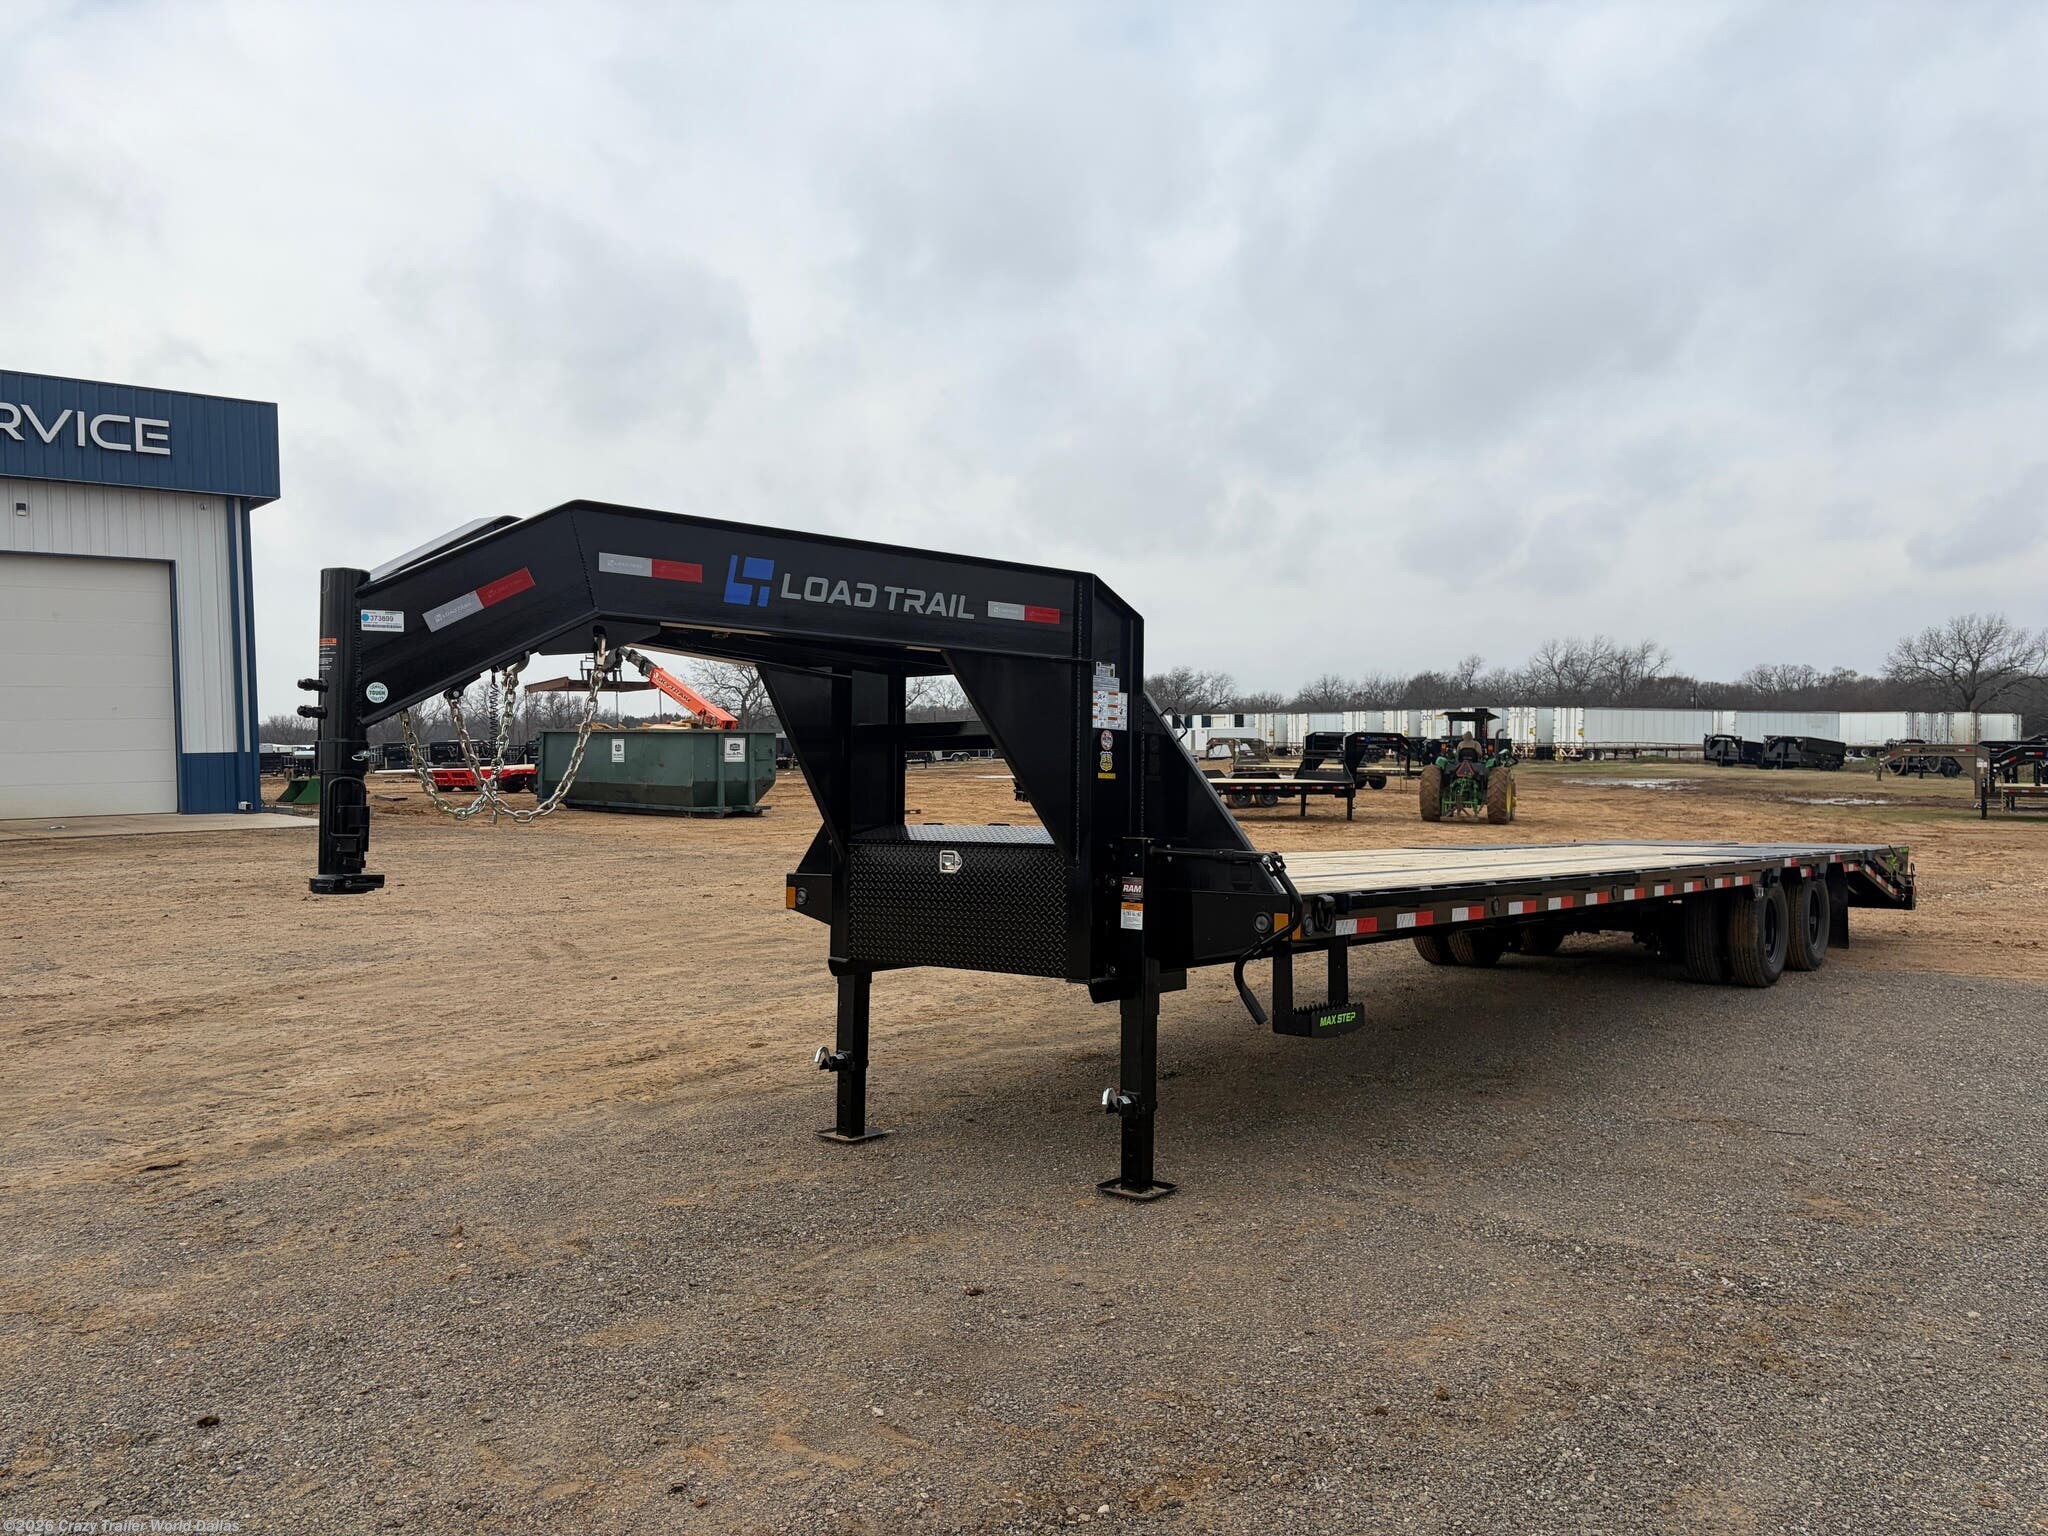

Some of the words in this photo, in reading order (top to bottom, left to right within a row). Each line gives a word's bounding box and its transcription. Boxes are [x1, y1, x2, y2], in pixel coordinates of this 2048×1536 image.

[780, 573, 878, 608] LOAD
[884, 586, 975, 620] TRAIL
[1123, 884, 1142, 893] RAM
[1320, 1014, 1336, 1027] MAX
[1337, 1011, 1356, 1023] STEP
